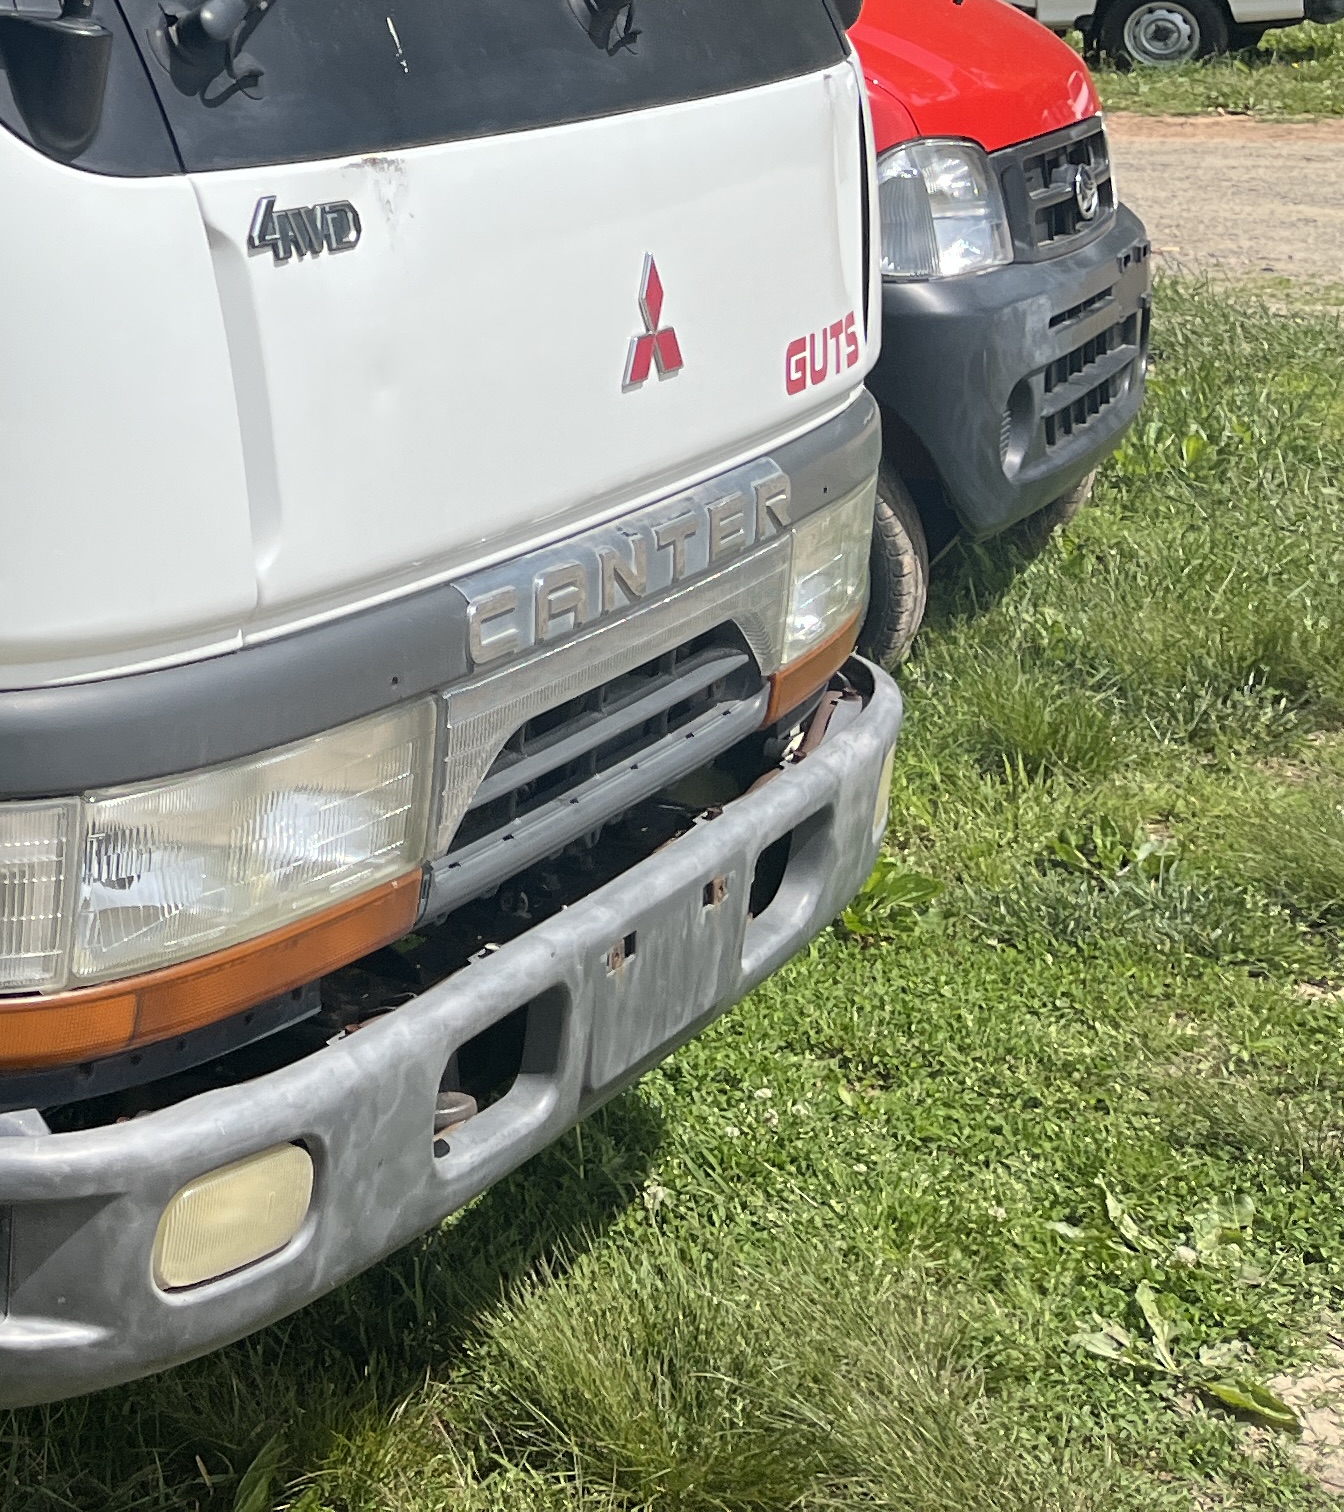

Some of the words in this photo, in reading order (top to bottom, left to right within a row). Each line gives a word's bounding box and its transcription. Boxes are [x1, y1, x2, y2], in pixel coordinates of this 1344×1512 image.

[247, 195, 362, 261] 4WD
[785, 310, 859, 396] GUTS
[468, 472, 792, 665] CANTER
